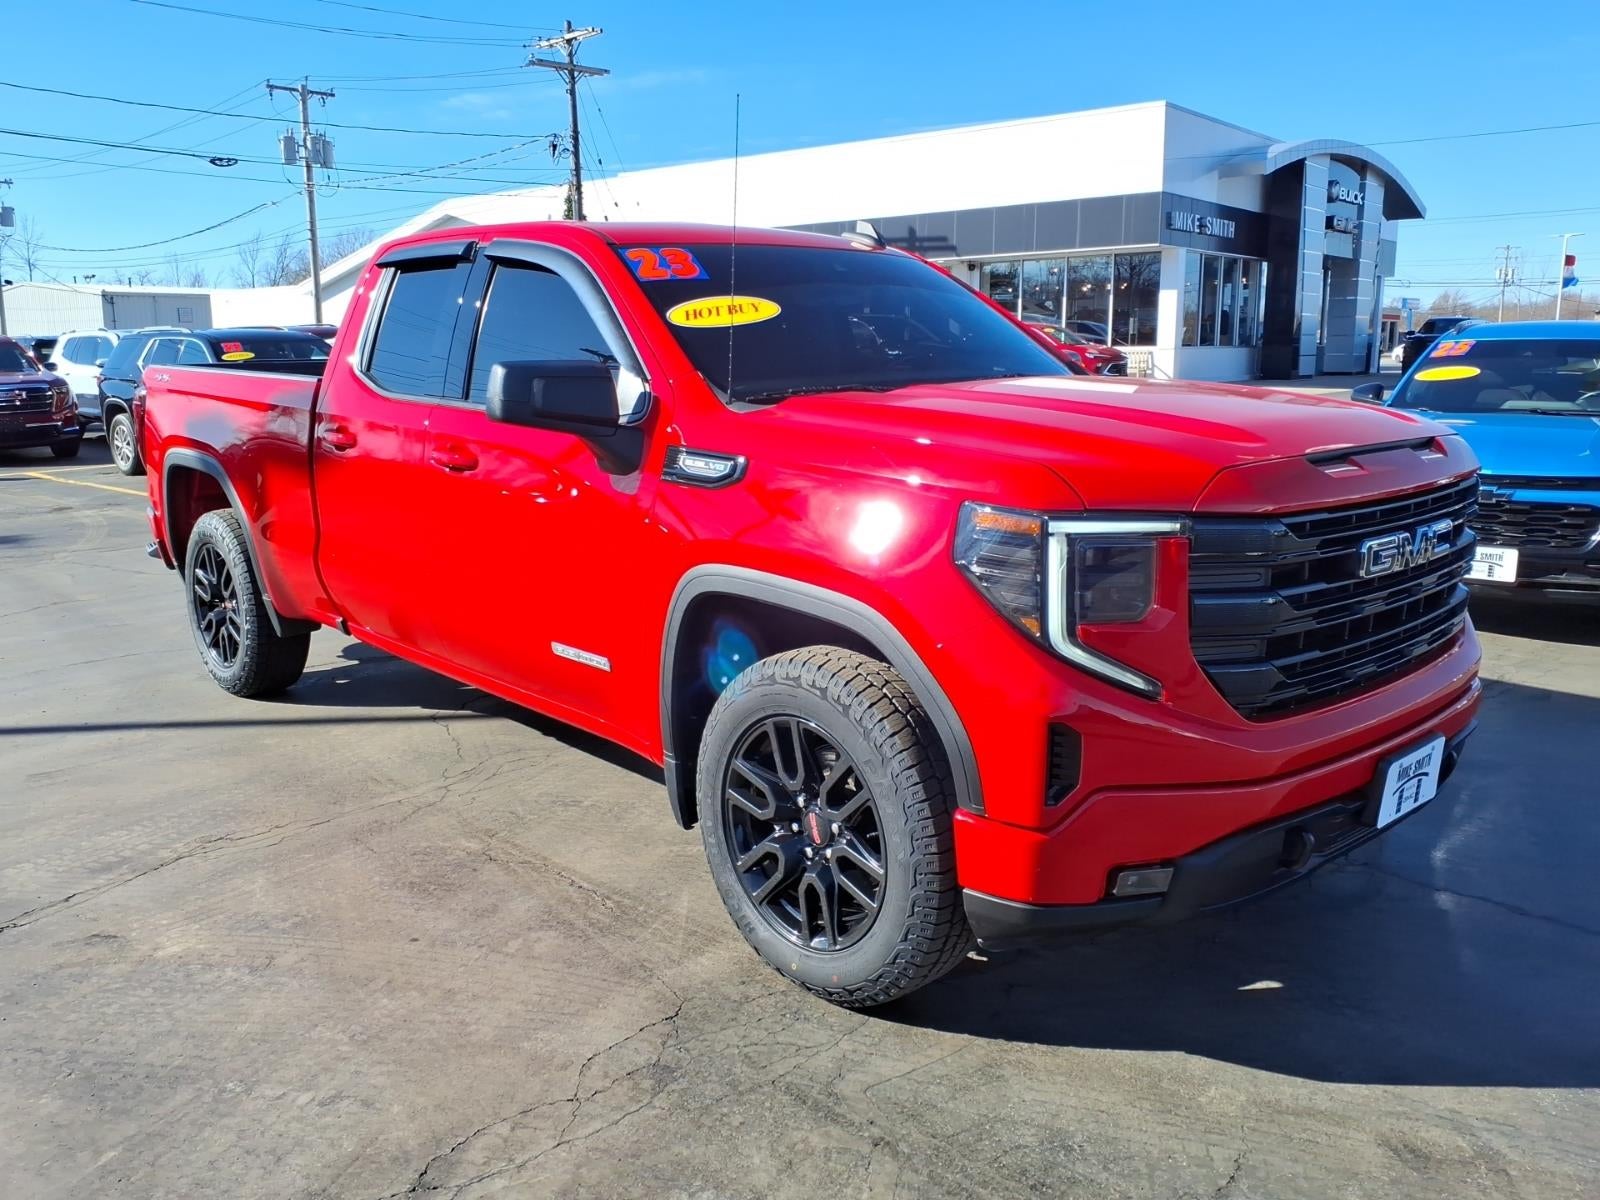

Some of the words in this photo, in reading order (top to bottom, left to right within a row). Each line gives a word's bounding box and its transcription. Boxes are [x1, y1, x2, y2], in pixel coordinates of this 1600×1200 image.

[1340, 187, 1364, 205] BUICK
[1175, 212, 1200, 233] MIKE
[1206, 218, 1236, 239] SMITH
[625, 248, 700, 280] 23
[685, 305, 725, 321] HOT
[728, 302, 762, 315] BUY
[1432, 342, 1471, 357] 25
[1360, 519, 1452, 578] GMC
[1480, 552, 1504, 561] SMITH
[1413, 752, 1433, 774] SMITH
